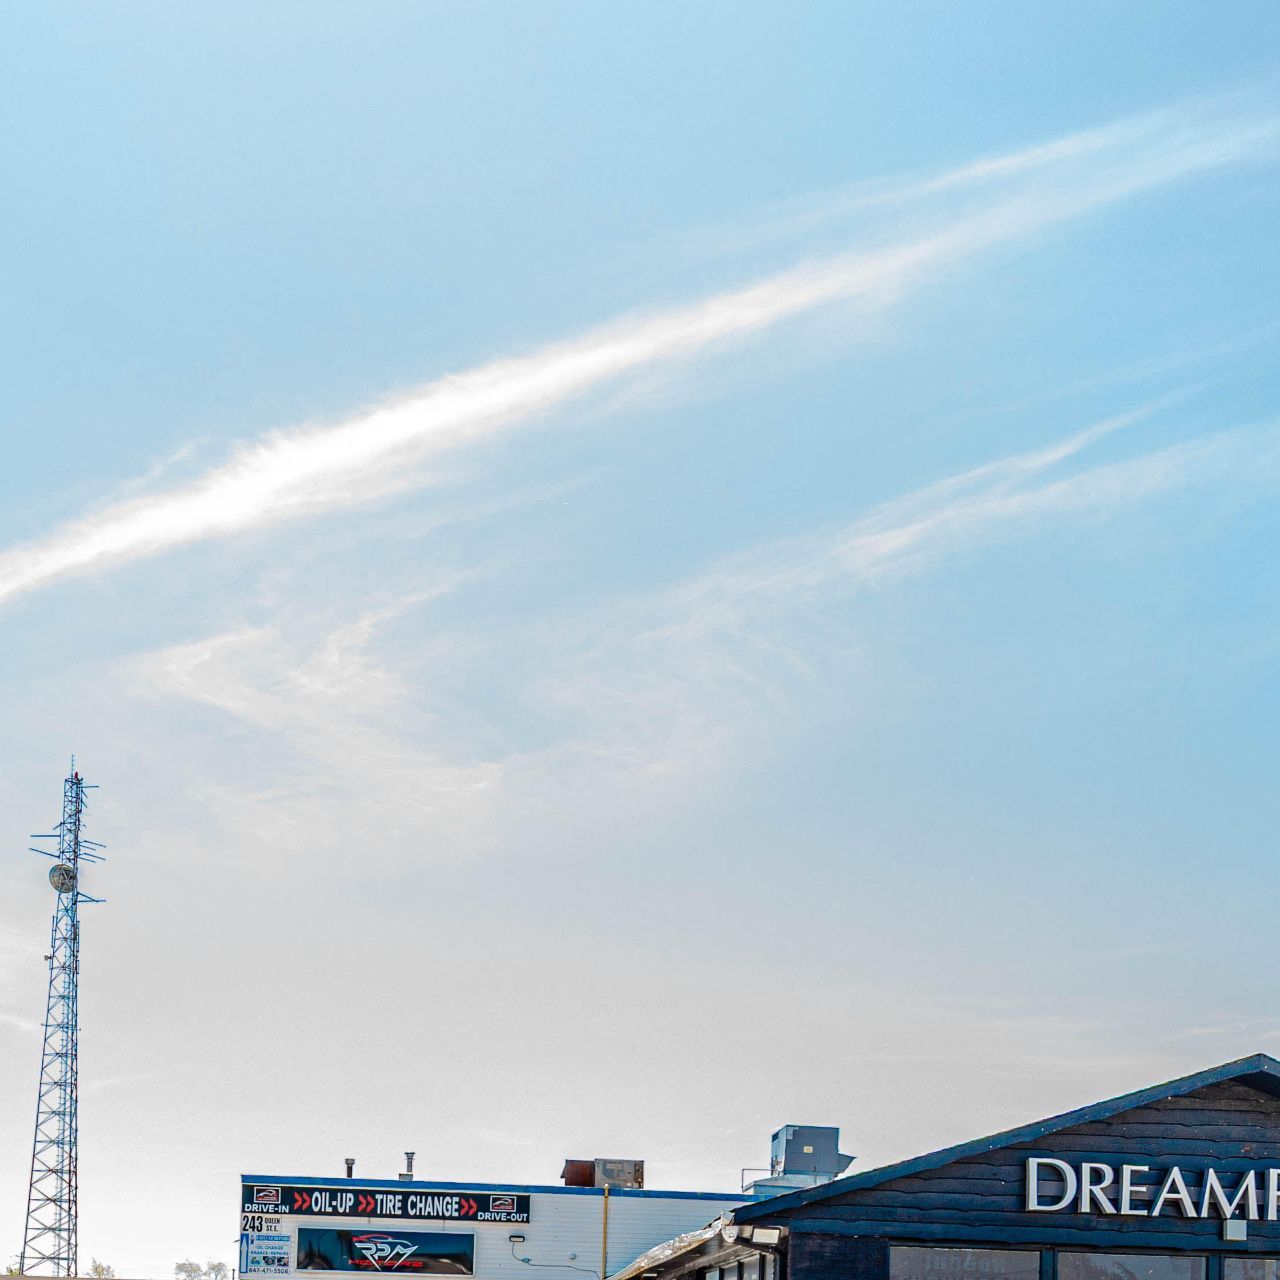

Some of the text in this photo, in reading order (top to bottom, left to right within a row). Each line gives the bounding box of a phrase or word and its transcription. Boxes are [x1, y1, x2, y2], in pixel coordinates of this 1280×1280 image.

[244, 1203, 290, 1213] DRIVE-IN
[311, 1191, 355, 1213] OIL-UP
[375, 1194, 460, 1217] TIRE CHANGE
[242, 1215, 263, 1232] 243
[477, 1211, 528, 1222] DRIVE-OUT
[354, 1242, 419, 1271] RPM
